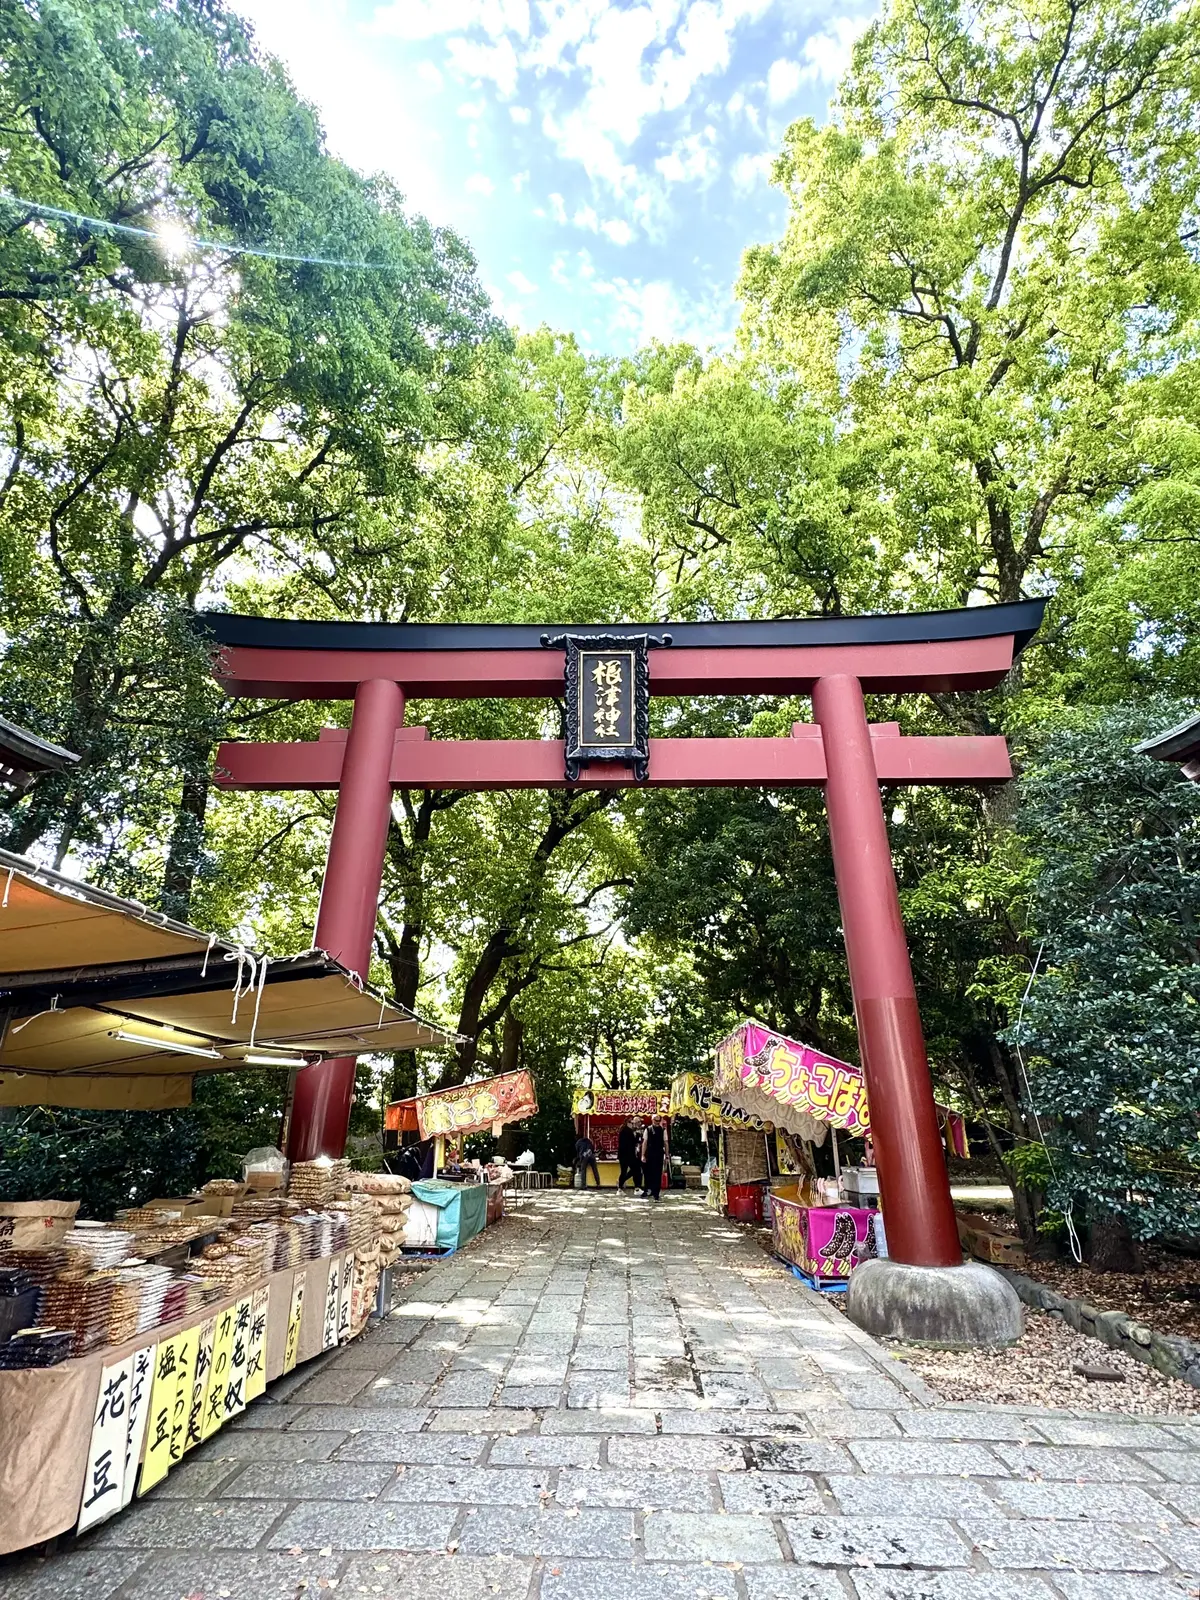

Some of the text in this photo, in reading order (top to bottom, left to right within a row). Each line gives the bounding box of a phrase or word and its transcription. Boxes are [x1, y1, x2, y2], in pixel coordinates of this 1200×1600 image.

[590, 660, 622, 738] 根津神社
[224, 1303, 250, 1413] 海老奴
[323, 1270, 339, 1350] 落花生
[84, 1370, 127, 1509] 花豆
[150, 1344, 176, 1452] 塩豆
